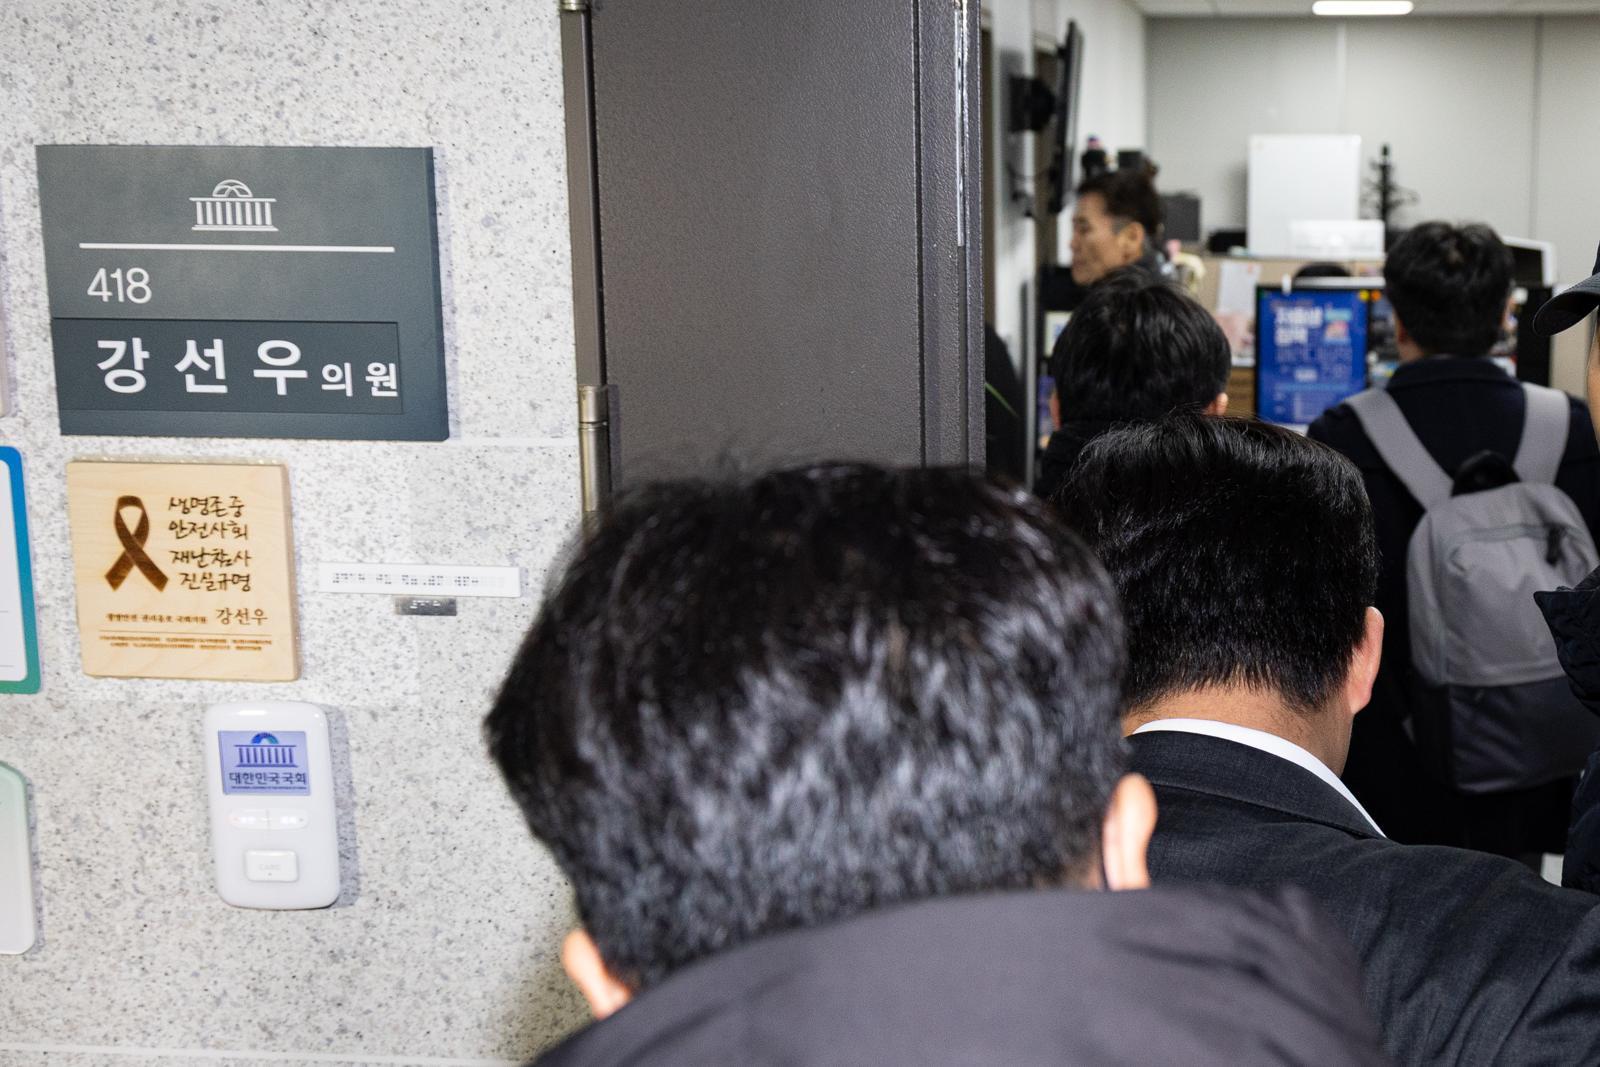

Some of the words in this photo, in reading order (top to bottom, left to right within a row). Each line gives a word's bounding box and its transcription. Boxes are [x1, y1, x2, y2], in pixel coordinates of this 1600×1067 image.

[87, 267, 152, 304] 418
[321, 362, 399, 398] 의원
[168, 496, 245, 518] 생명존중
[168, 520, 249, 540] 안전사회
[169, 546, 252, 569] 재난참사
[178, 572, 251, 592] 진실규명
[216, 607, 268, 626] 강선우
